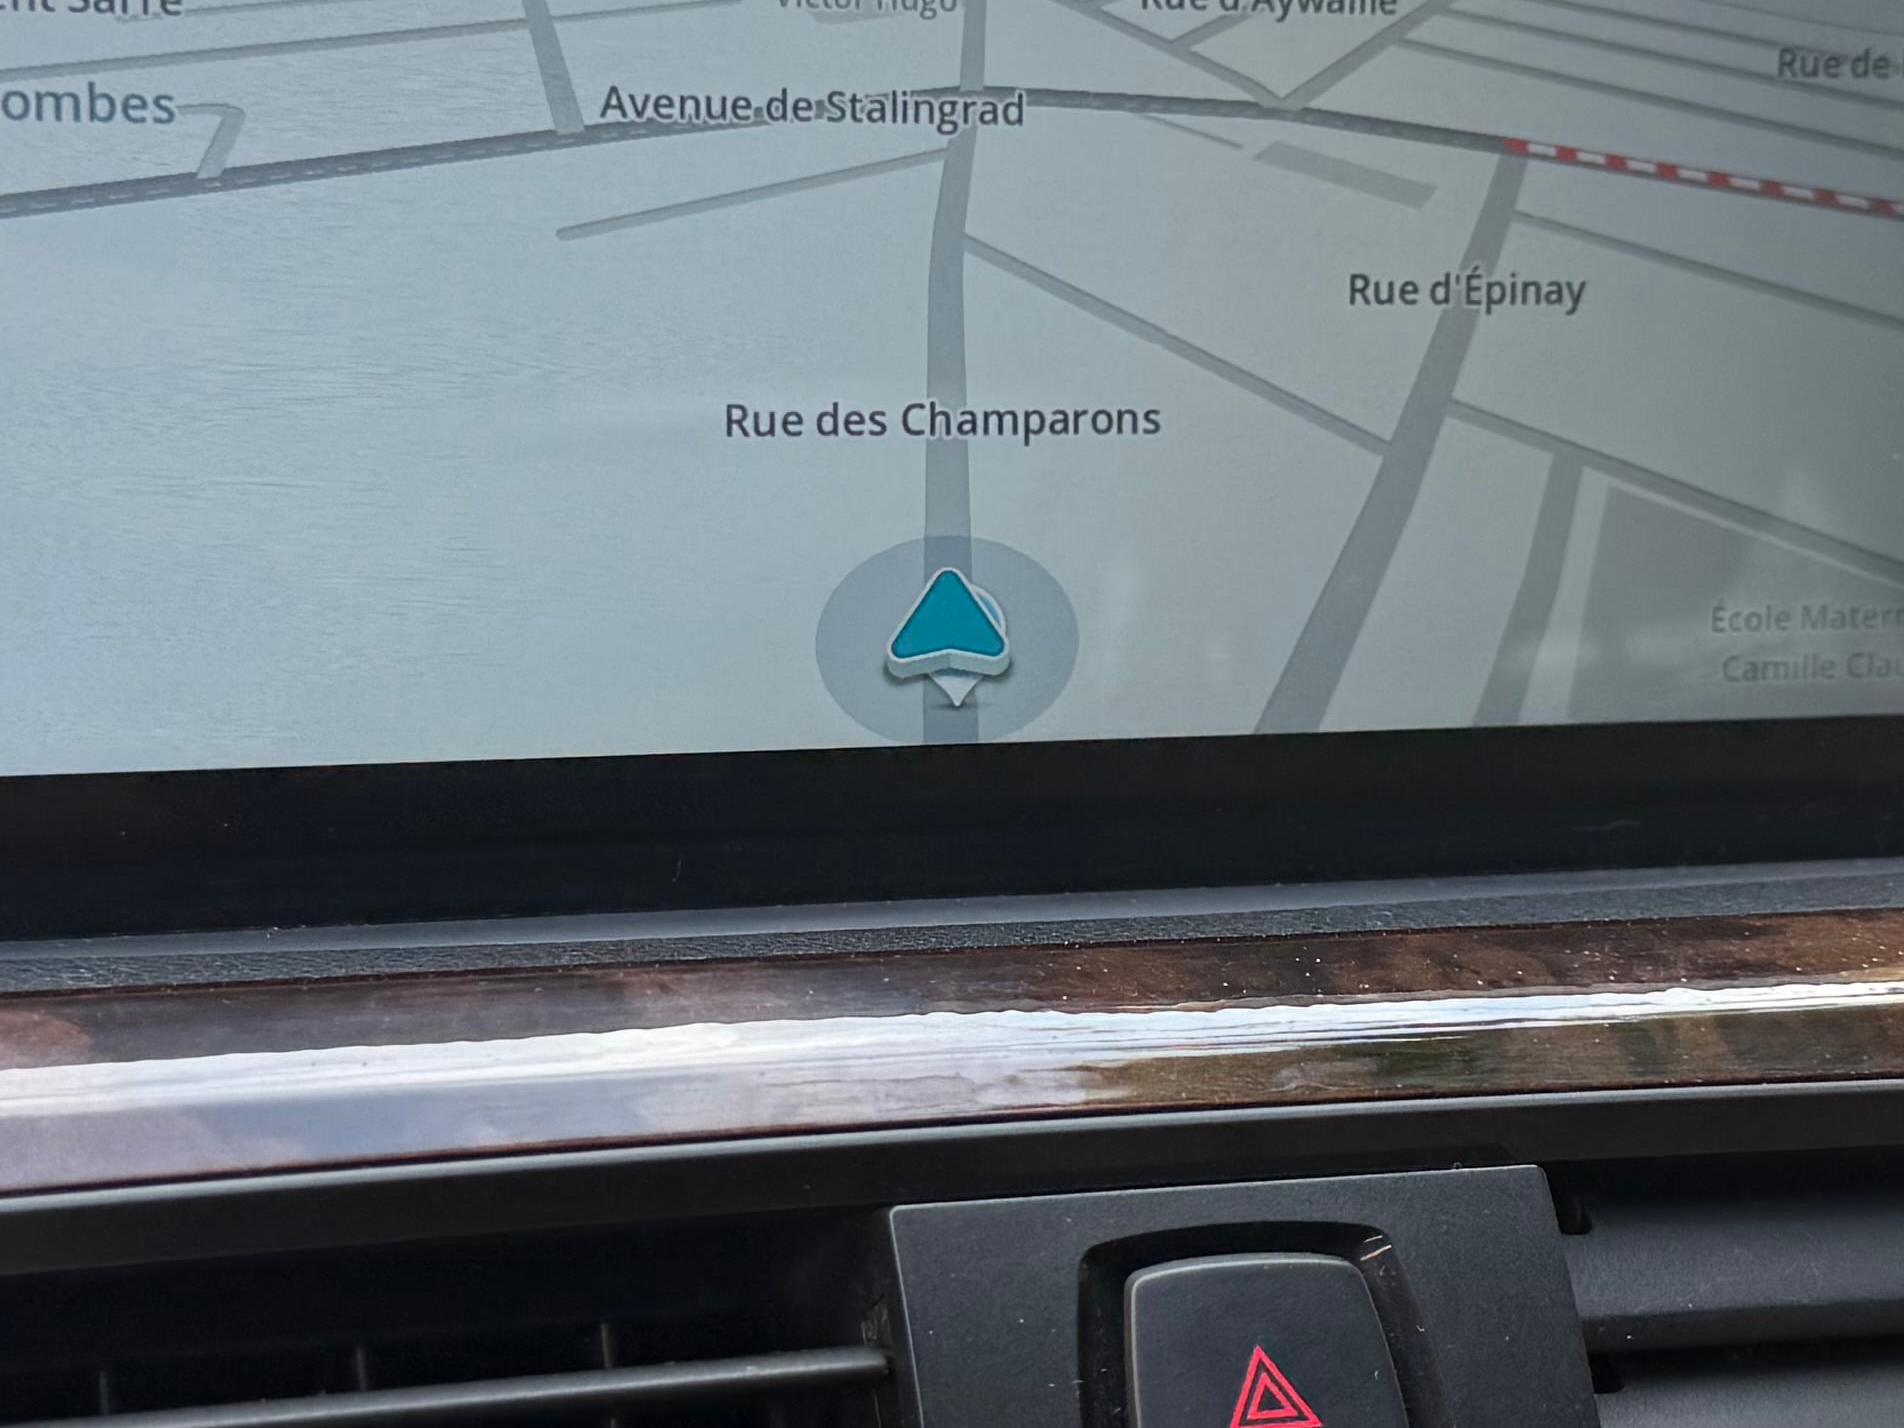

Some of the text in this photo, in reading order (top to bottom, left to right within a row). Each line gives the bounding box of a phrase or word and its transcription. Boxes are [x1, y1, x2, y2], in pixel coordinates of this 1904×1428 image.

[1778, 49, 1843, 80] Rue
[1851, 48, 1892, 80] de
[601, 86, 1025, 136] Avenue de Stalingrad
[1349, 269, 1587, 316] Rue d'Épinay
[725, 402, 1162, 445] Rue des Champarons
[1711, 600, 1791, 633] École
[1723, 654, 1836, 683] Camille
